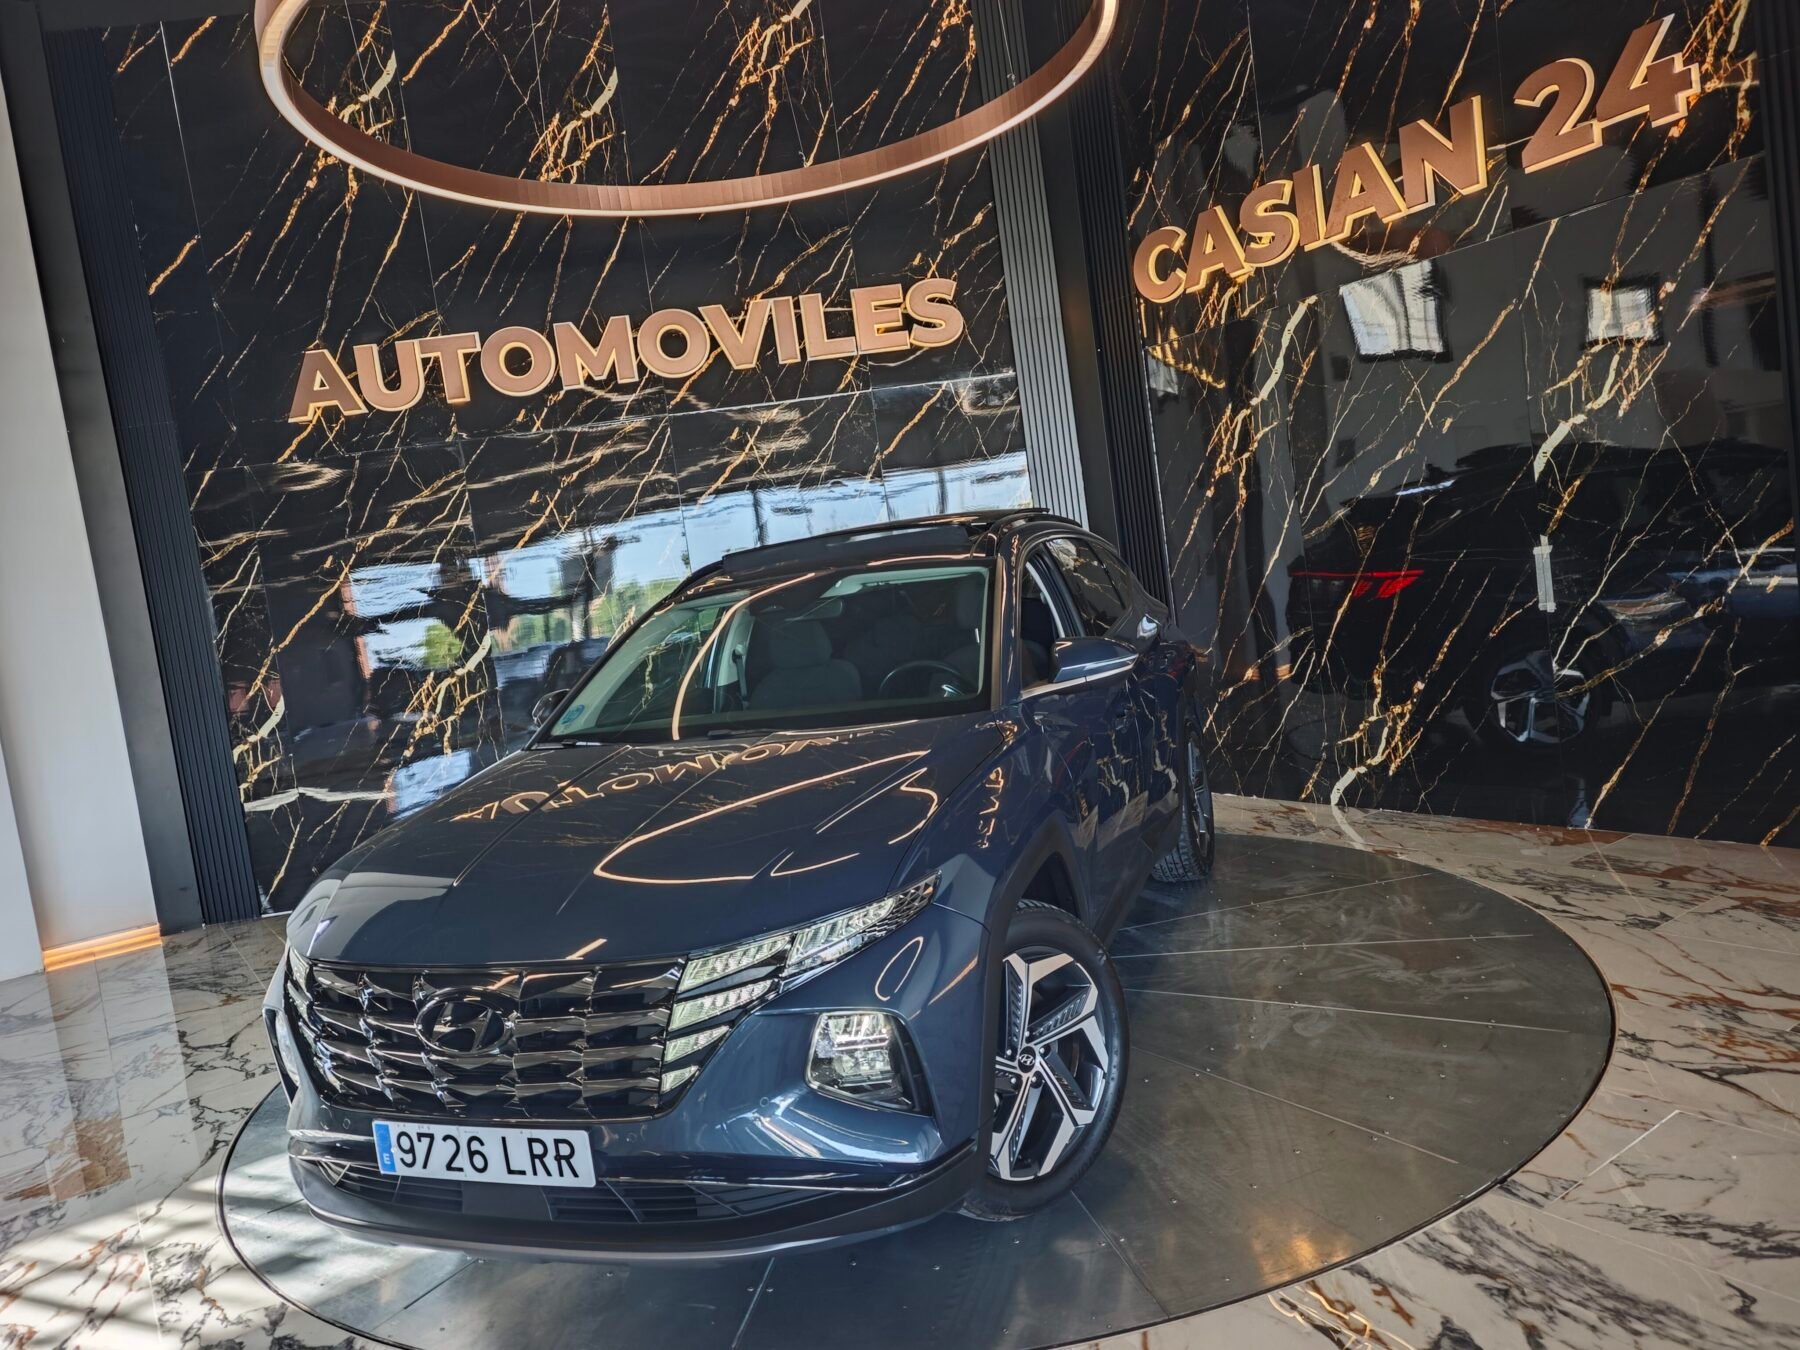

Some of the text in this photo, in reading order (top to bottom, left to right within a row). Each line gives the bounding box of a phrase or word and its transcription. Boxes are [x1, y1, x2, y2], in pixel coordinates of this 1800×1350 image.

[1133, 12, 1701, 304] CASIAN 24
[287, 277, 964, 423] AUTOMOVILES
[383, 1152, 391, 1165] E
[396, 1131, 580, 1178] 9726 LRR
